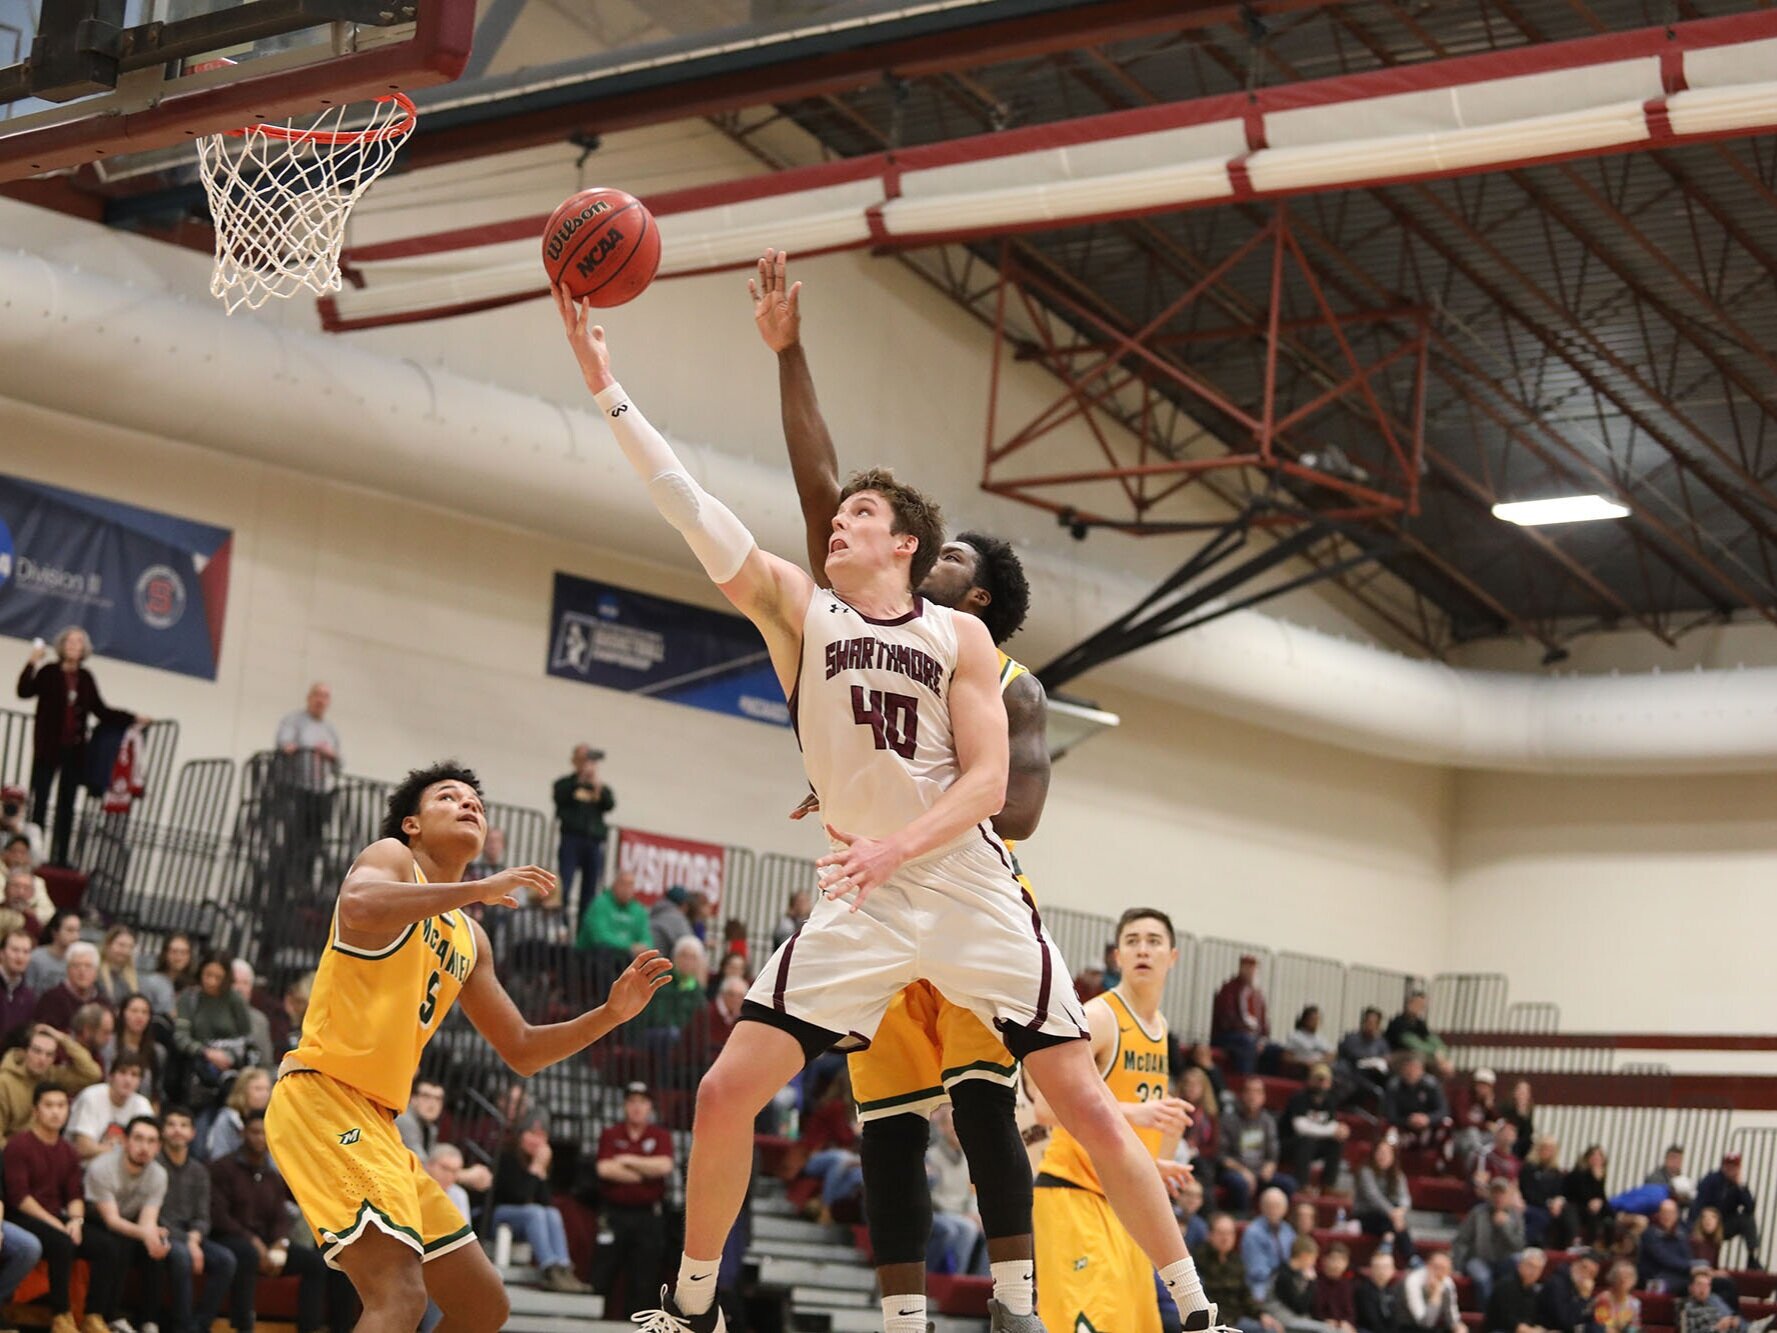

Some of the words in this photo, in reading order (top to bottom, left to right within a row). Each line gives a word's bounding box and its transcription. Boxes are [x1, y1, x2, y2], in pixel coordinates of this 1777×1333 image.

[547, 200, 614, 261] Wilson
[576, 226, 625, 279] NCAA
[825, 636, 944, 700] SWARTHMORE
[850, 684, 919, 761] 40
[620, 840, 722, 904] VISITORS
[417, 969, 441, 1028] 5
